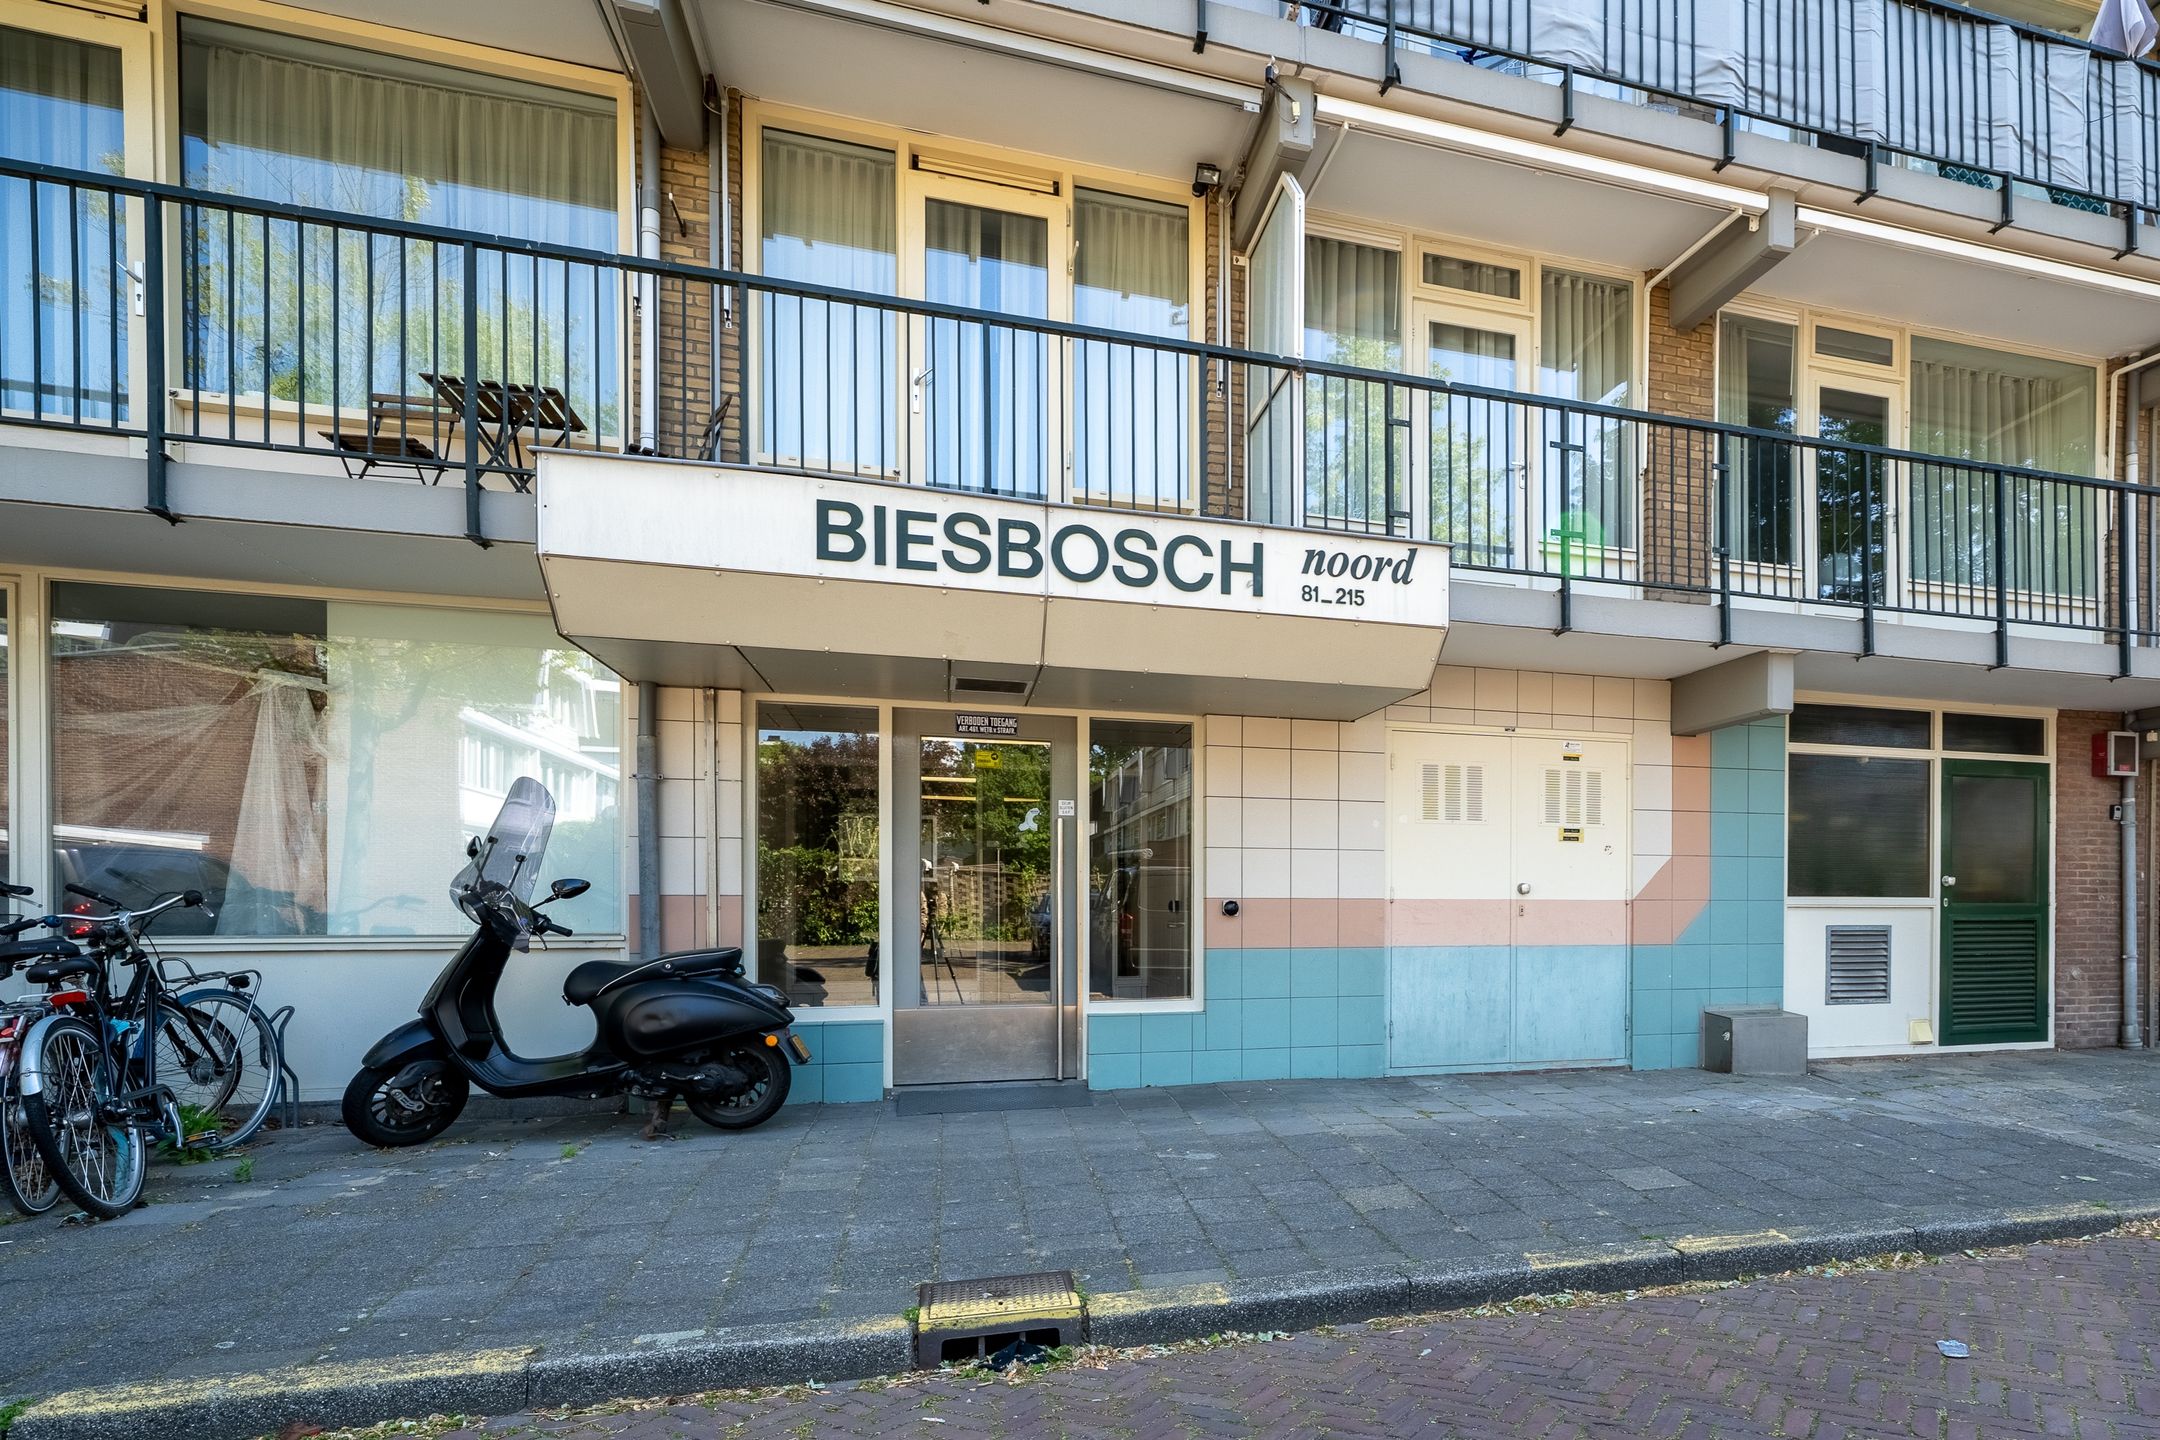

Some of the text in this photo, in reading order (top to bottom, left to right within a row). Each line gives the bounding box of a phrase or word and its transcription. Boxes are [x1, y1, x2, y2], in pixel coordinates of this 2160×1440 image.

[816, 499, 1418, 597] BIESBOSCH noord
[956, 715, 1017, 728] VERBODEN TOEGANG
